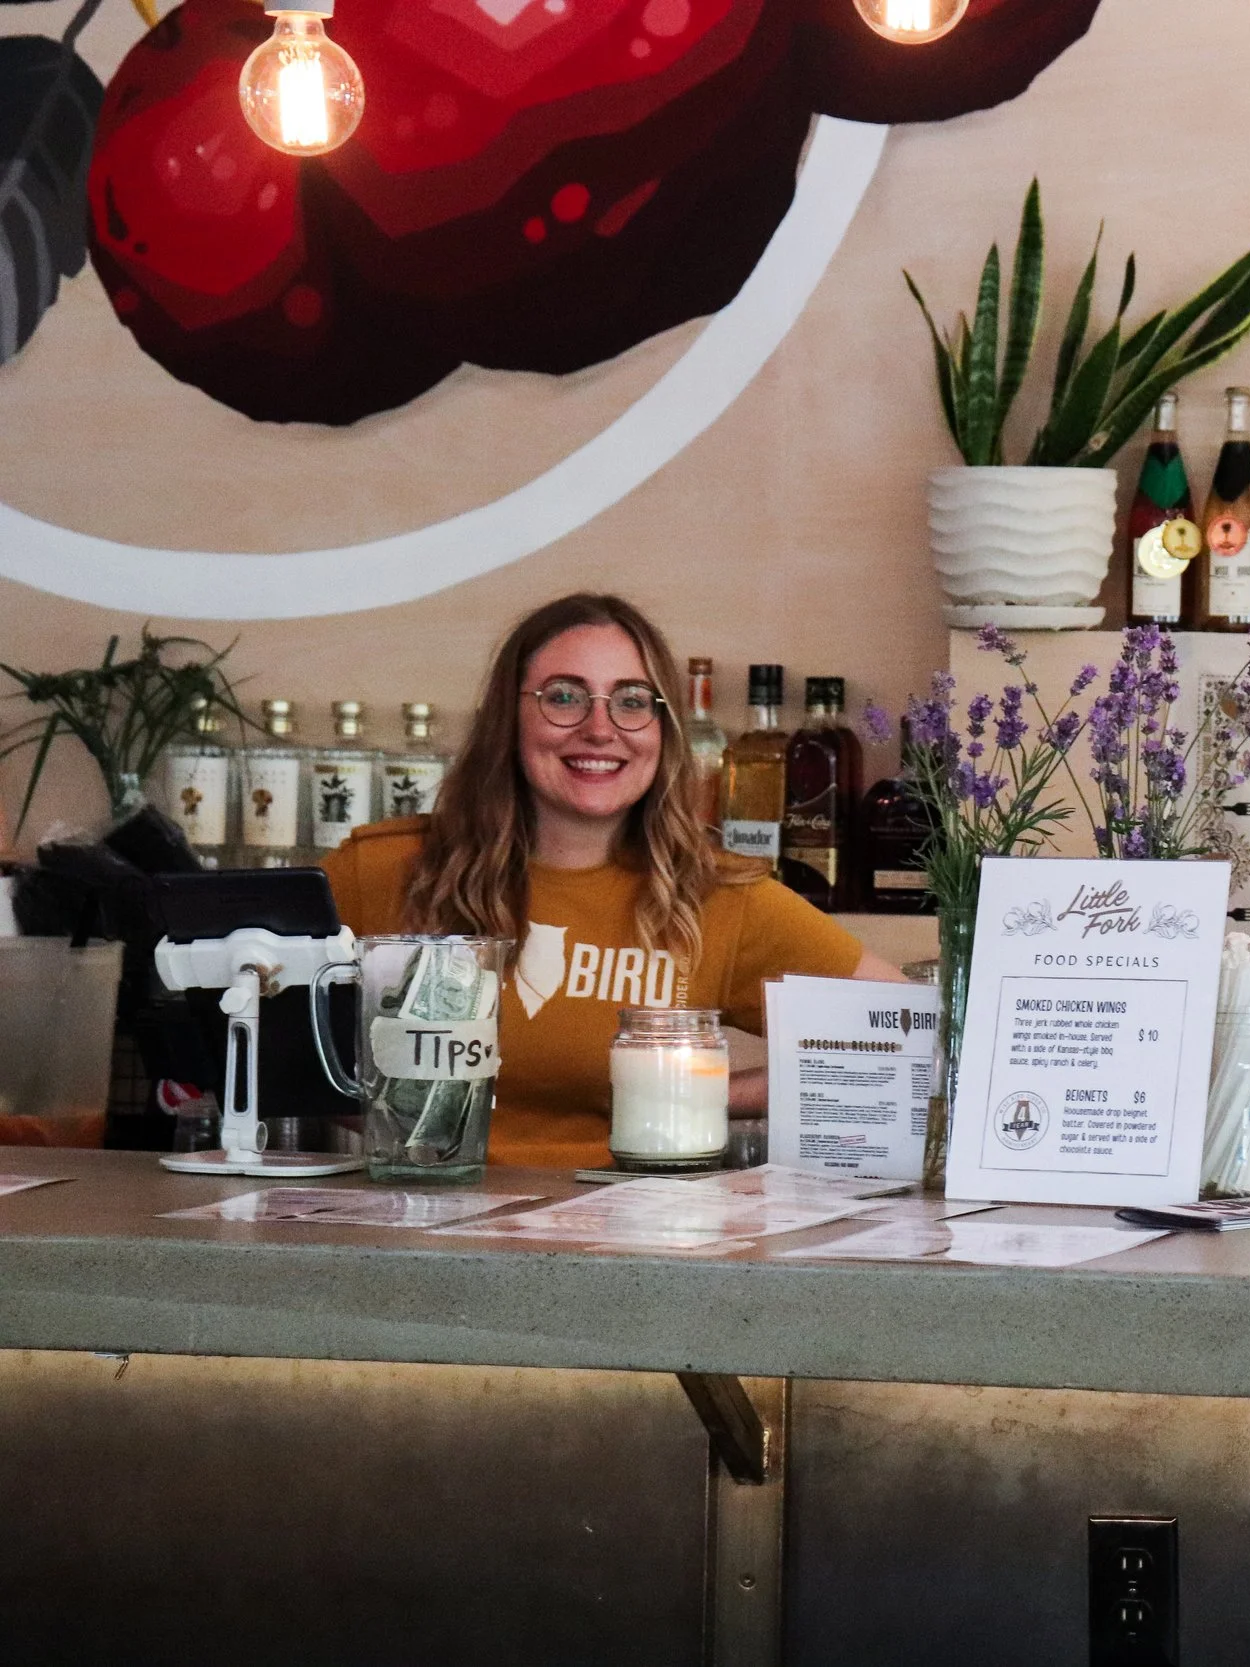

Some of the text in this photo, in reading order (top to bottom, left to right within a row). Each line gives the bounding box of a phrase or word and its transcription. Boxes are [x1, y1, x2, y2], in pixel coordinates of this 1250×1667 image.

[1057, 879, 1130, 921] Little
[1081, 905, 1142, 939] Fork
[1034, 954, 1160, 968] FOOD SPECIALS
[565, 942, 675, 1008] BIRD
[1015, 999, 1127, 1013] SMOKED CHICKEN WINGS
[868, 1010, 899, 1029] WISE
[1014, 1018, 1119, 1029] Three jerk rubbed whole chicken
[1012, 1032, 1030, 1040] wings
[1033, 1032, 1056, 1040] smoked
[1090, 1033, 1112, 1041] Served
[1147, 1030, 1159, 1041] 10
[803, 1039, 897, 1053] SPECIAL RELEASE
[1011, 1045, 1025, 1053] with
[1033, 1045, 1045, 1053] side
[1048, 1045, 1055, 1053] of
[1101, 1046, 1113, 1055] bbq
[1031, 1058, 1047, 1067] spicy
[1050, 1059, 1068, 1067] ranch
[1065, 1089, 1146, 1103] BEIGNETS $6
[1106, 1108, 1120, 1117] drop
[1123, 1109, 1148, 1119] beignet
[1087, 1120, 1114, 1128] Covered
[1123, 1122, 1156, 1130] powdered
[1061, 1133, 1078, 1141] sugar
[1088, 1134, 1110, 1142] served
[1112, 1134, 1127, 1142] with
[1134, 1135, 1147, 1143] side
[1059, 1145, 1091, 1153] chocolate
